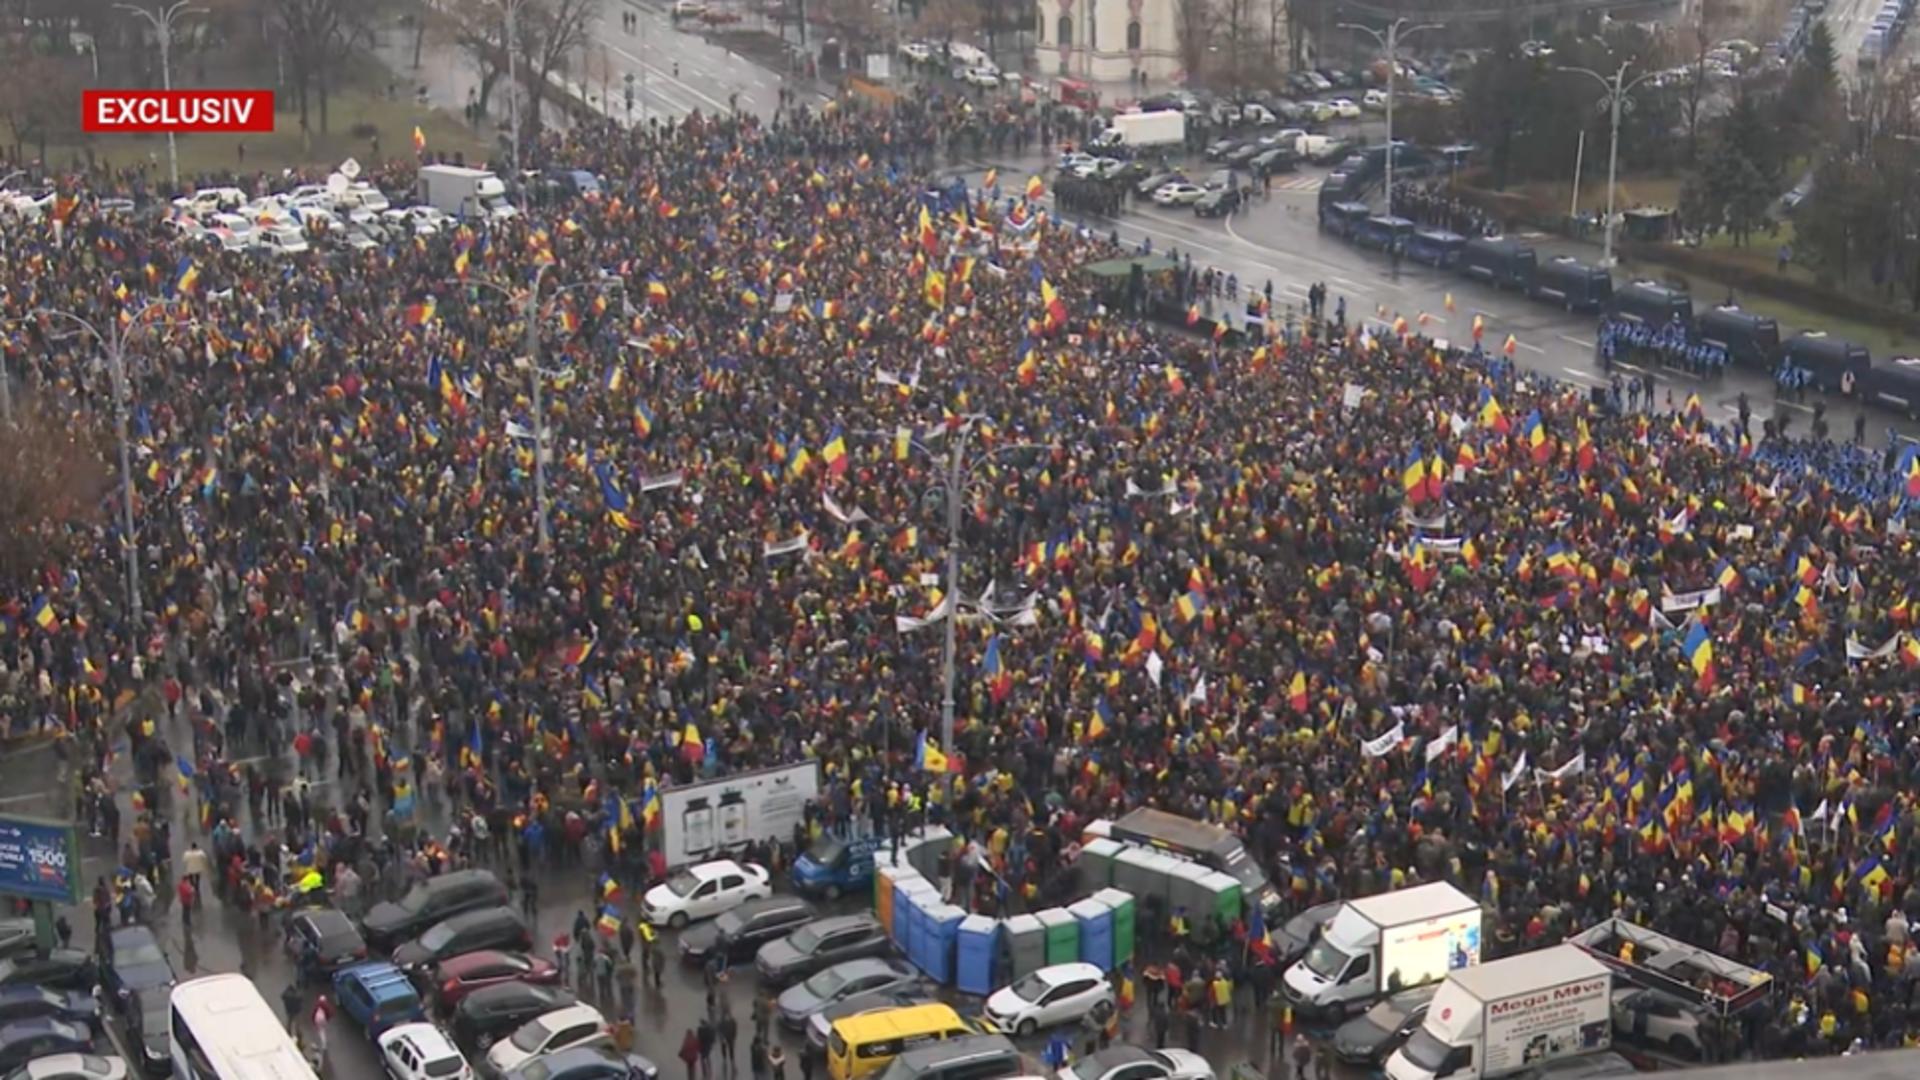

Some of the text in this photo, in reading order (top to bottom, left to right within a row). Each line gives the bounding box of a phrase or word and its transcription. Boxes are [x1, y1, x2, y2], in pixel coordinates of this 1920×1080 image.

[28, 848, 67, 867] 1500
[1490, 993, 1548, 1015] Mega
[1553, 981, 1605, 999] Move
